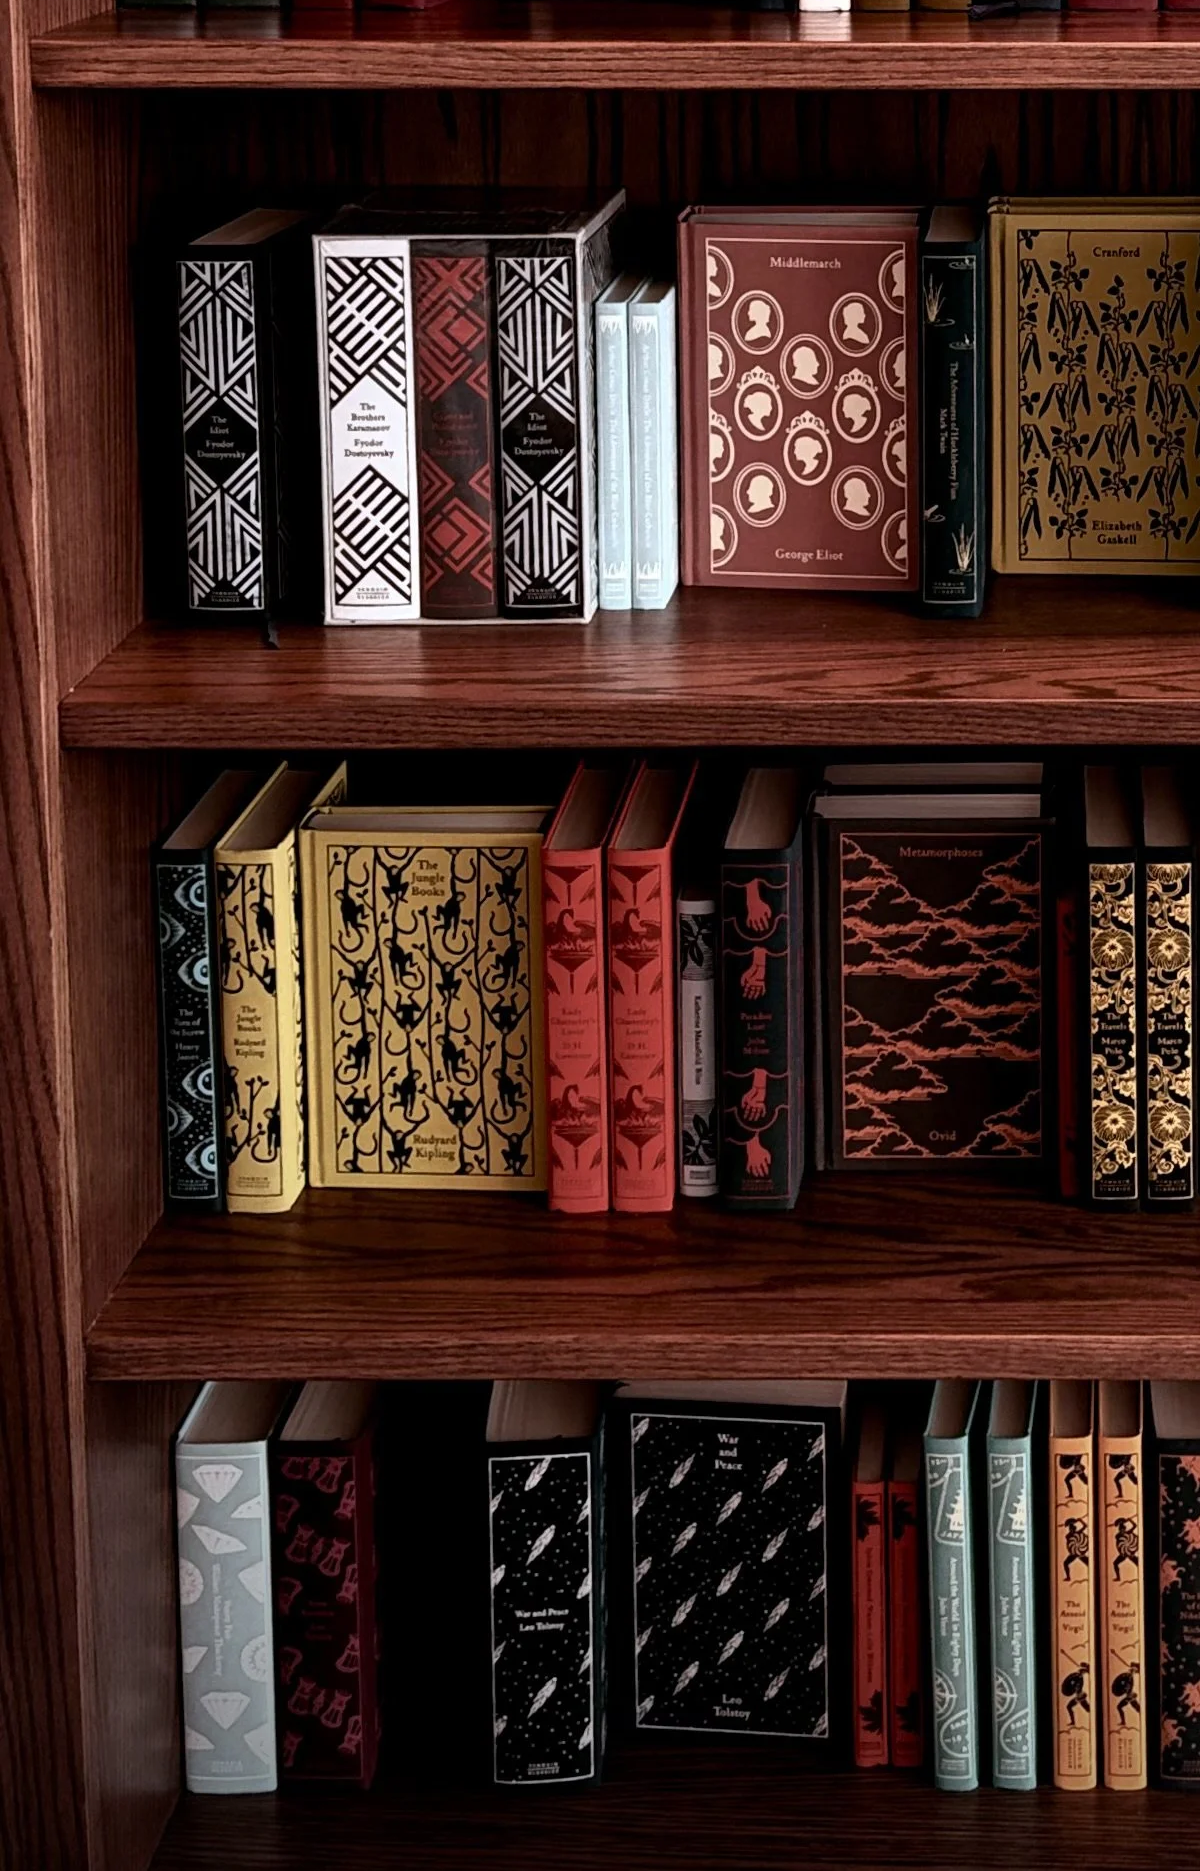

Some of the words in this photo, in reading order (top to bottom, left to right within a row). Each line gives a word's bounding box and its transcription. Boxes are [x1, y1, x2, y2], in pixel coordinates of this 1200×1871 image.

[1092, 246, 1140, 257] Cranford
[770, 256, 841, 269] Middlemarch
[360, 403, 375, 411] The
[351, 412, 385, 421] Brothers
[529, 412, 544, 421] The
[528, 423, 547, 432] Idiot
[354, 439, 383, 450] Fyodor
[523, 436, 552, 447] Fyodor
[344, 448, 393, 459] Dostoyevsky
[514, 446, 564, 457] Dostoyevsky
[1092, 520, 1142, 532] Elizabeth
[1097, 534, 1137, 545] Gaskell
[775, 549, 813, 562] George
[816, 549, 843, 561] Eliot
[899, 846, 983, 859] Metamorphoses
[417, 860, 438, 870] The
[412, 872, 445, 885] Jungle
[412, 887, 445, 897] Books
[413, 1134, 456, 1146] Rudyard
[929, 1130, 956, 1141] Ovid
[416, 1147, 455, 1160] Kipling
[718, 1434, 738, 1444] War
[720, 1448, 737, 1457] and
[715, 1460, 742, 1471] Peace
[515, 1610, 530, 1618] War
[520, 1623, 534, 1632] Leo
[536, 1622, 564, 1631] Tolstoy
[722, 1694, 742, 1704] Leo
[713, 1706, 750, 1719] Tolstoy
